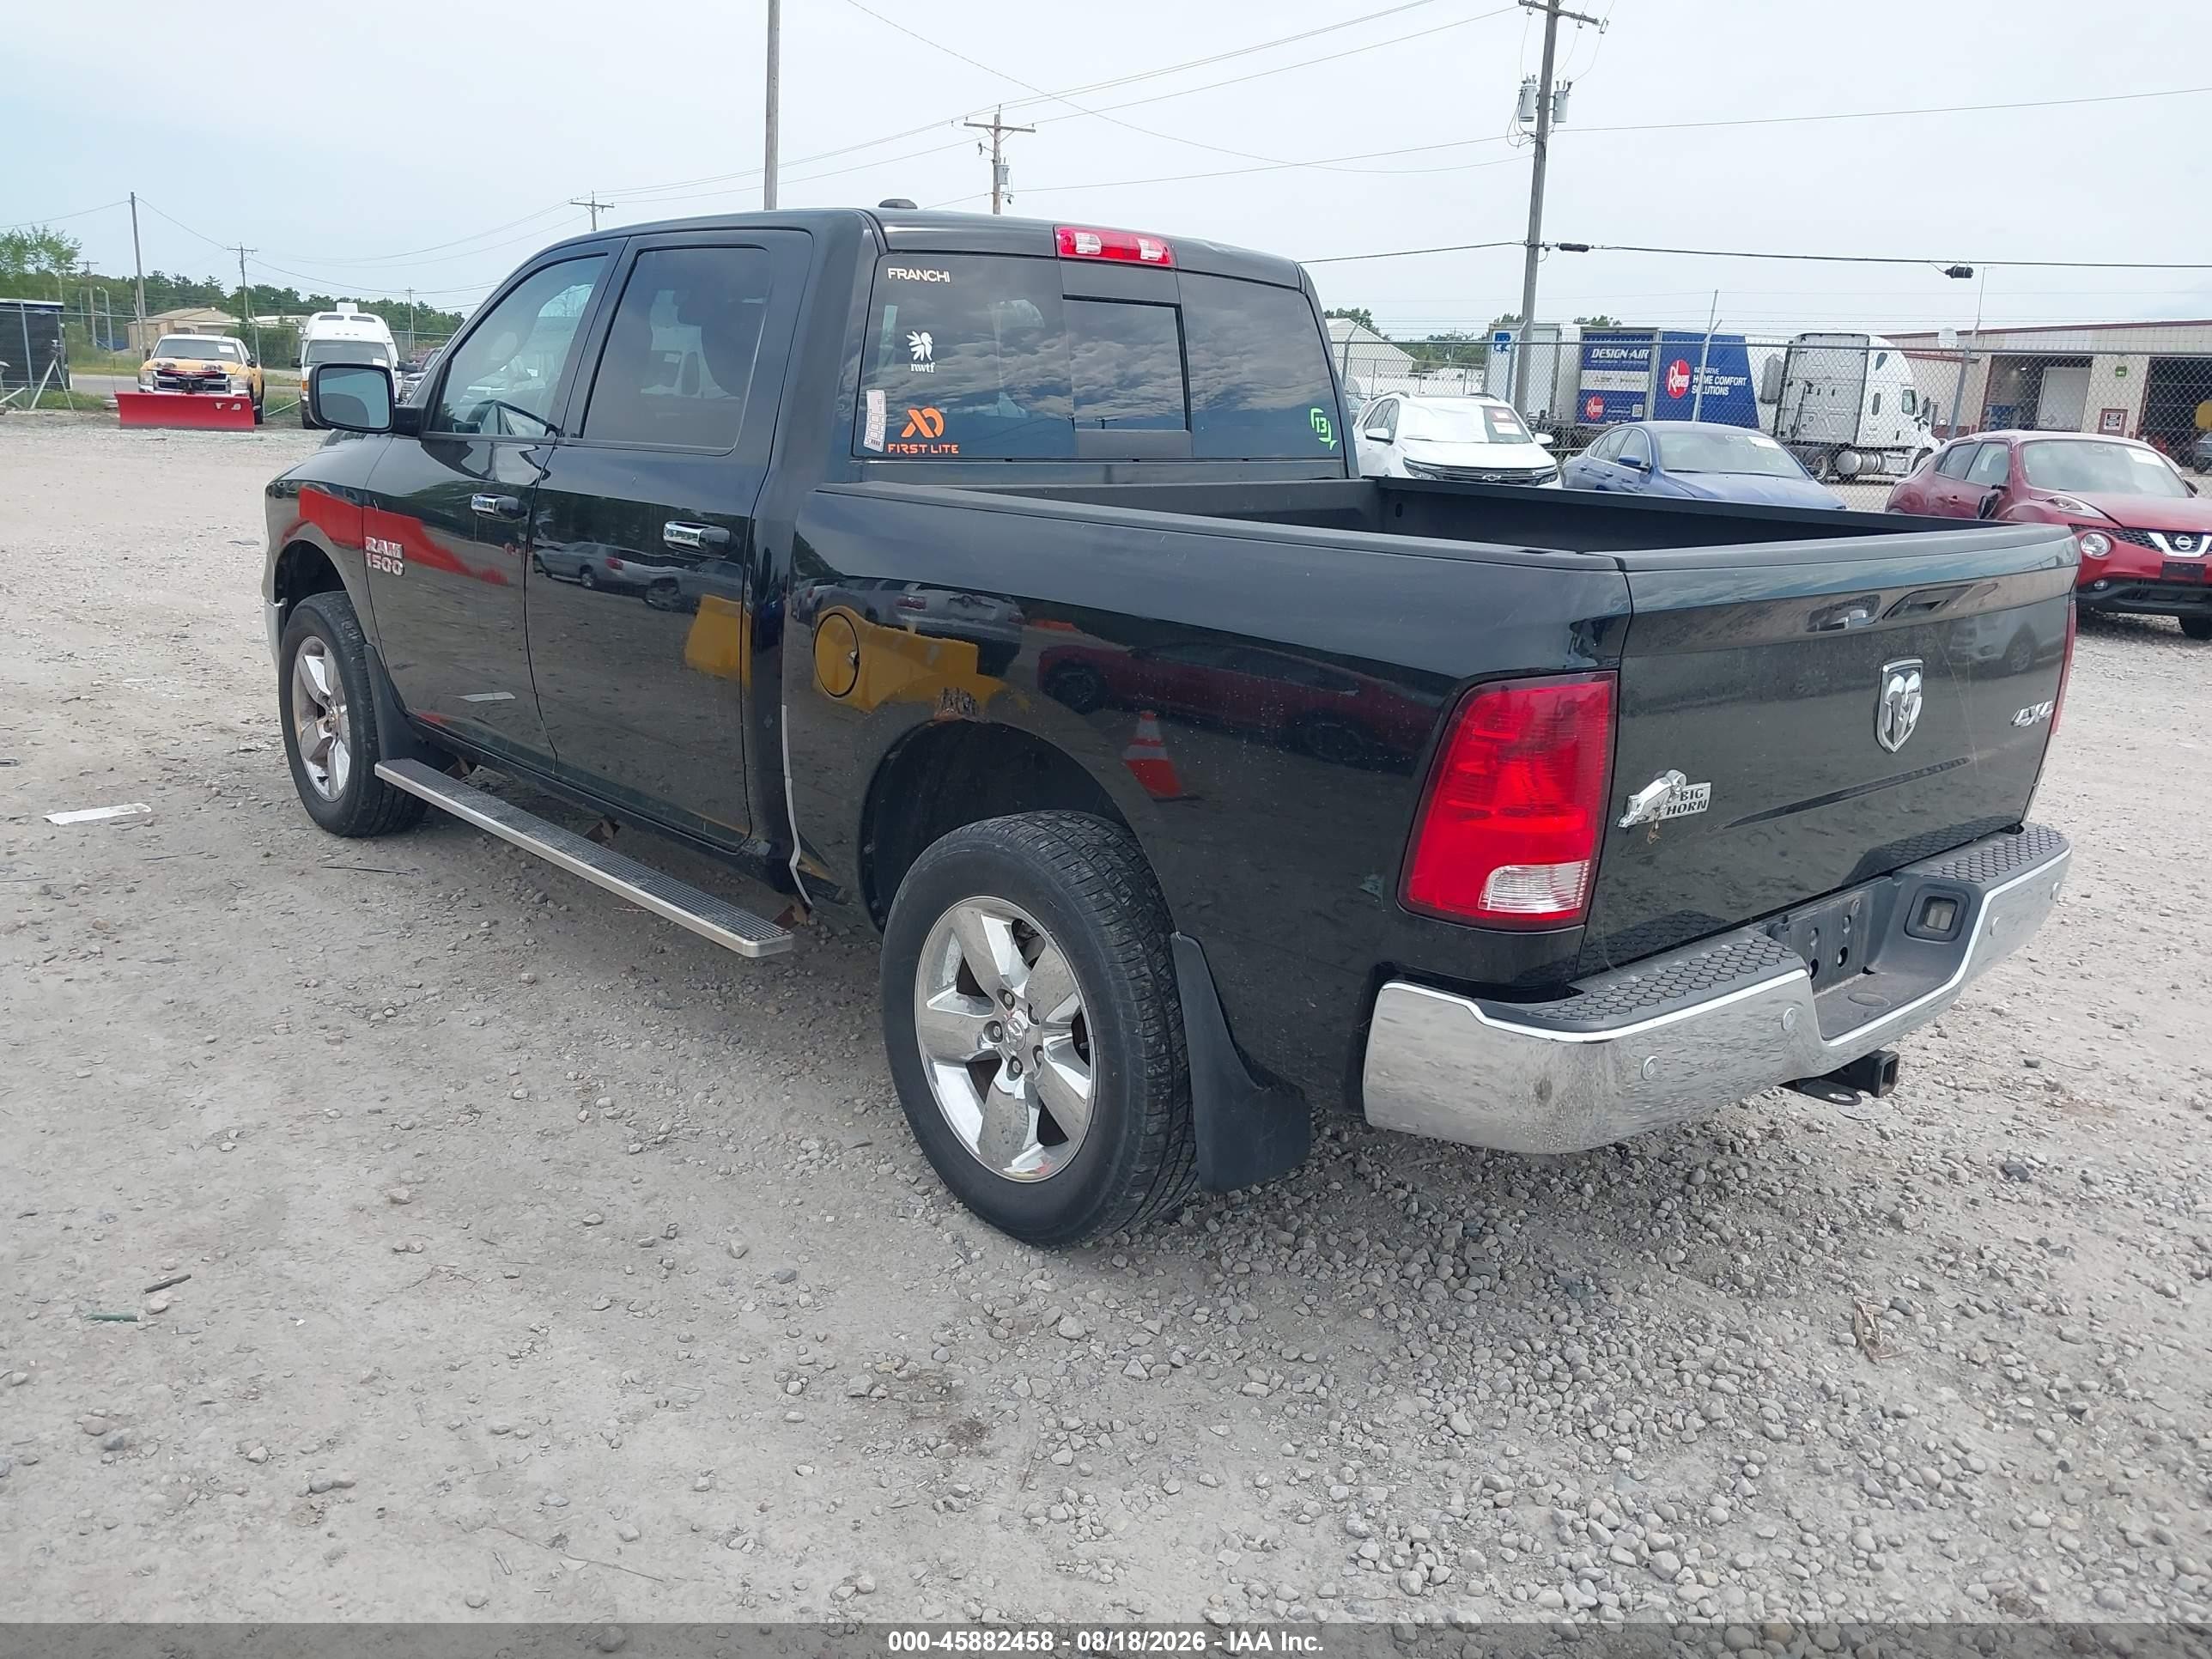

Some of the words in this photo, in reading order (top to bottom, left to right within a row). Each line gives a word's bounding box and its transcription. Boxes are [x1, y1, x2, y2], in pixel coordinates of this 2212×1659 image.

[887, 267, 951, 283] FRANCHI
[1591, 348, 1629, 359] DESIGN
[910, 362, 935, 374] nwtf
[1692, 374, 1714, 385] HME
[1714, 376, 1747, 386] COMFORT
[1691, 385, 1729, 396] SUTIONS
[1315, 416, 1328, 434] 13
[888, 443, 927, 453] FIRST
[930, 444, 959, 454] LITE
[365, 536, 404, 559] RAM
[366, 552, 404, 576] 1500
[1680, 788, 1705, 801] BIG
[1666, 799, 1707, 816] HORN
